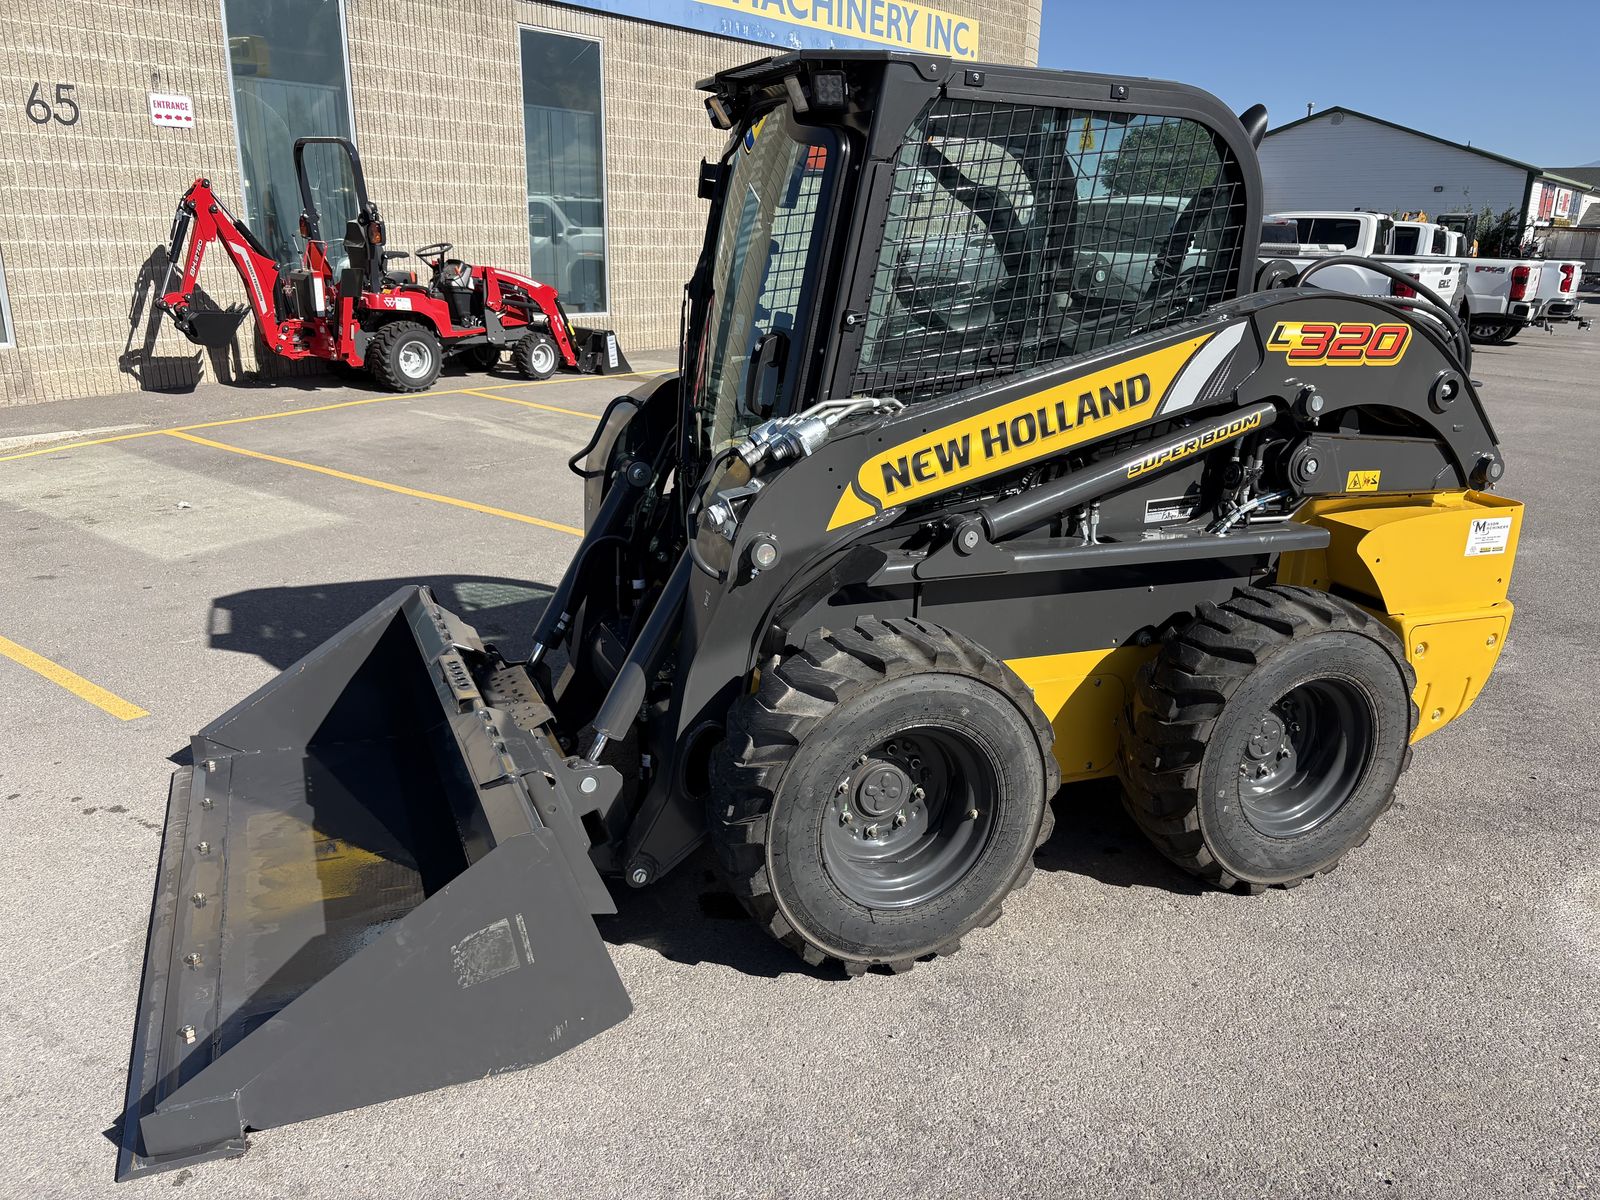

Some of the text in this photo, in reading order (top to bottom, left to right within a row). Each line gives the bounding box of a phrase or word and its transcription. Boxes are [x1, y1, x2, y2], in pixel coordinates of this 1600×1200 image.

[926, 14, 975, 58] INC.
[26, 82, 80, 126] 65
[153, 100, 189, 111] ENTRANCE
[1267, 322, 1412, 366] L320
[880, 373, 1152, 494] NEW HOLLAND
[1128, 411, 1262, 478] SUPER BOOM
